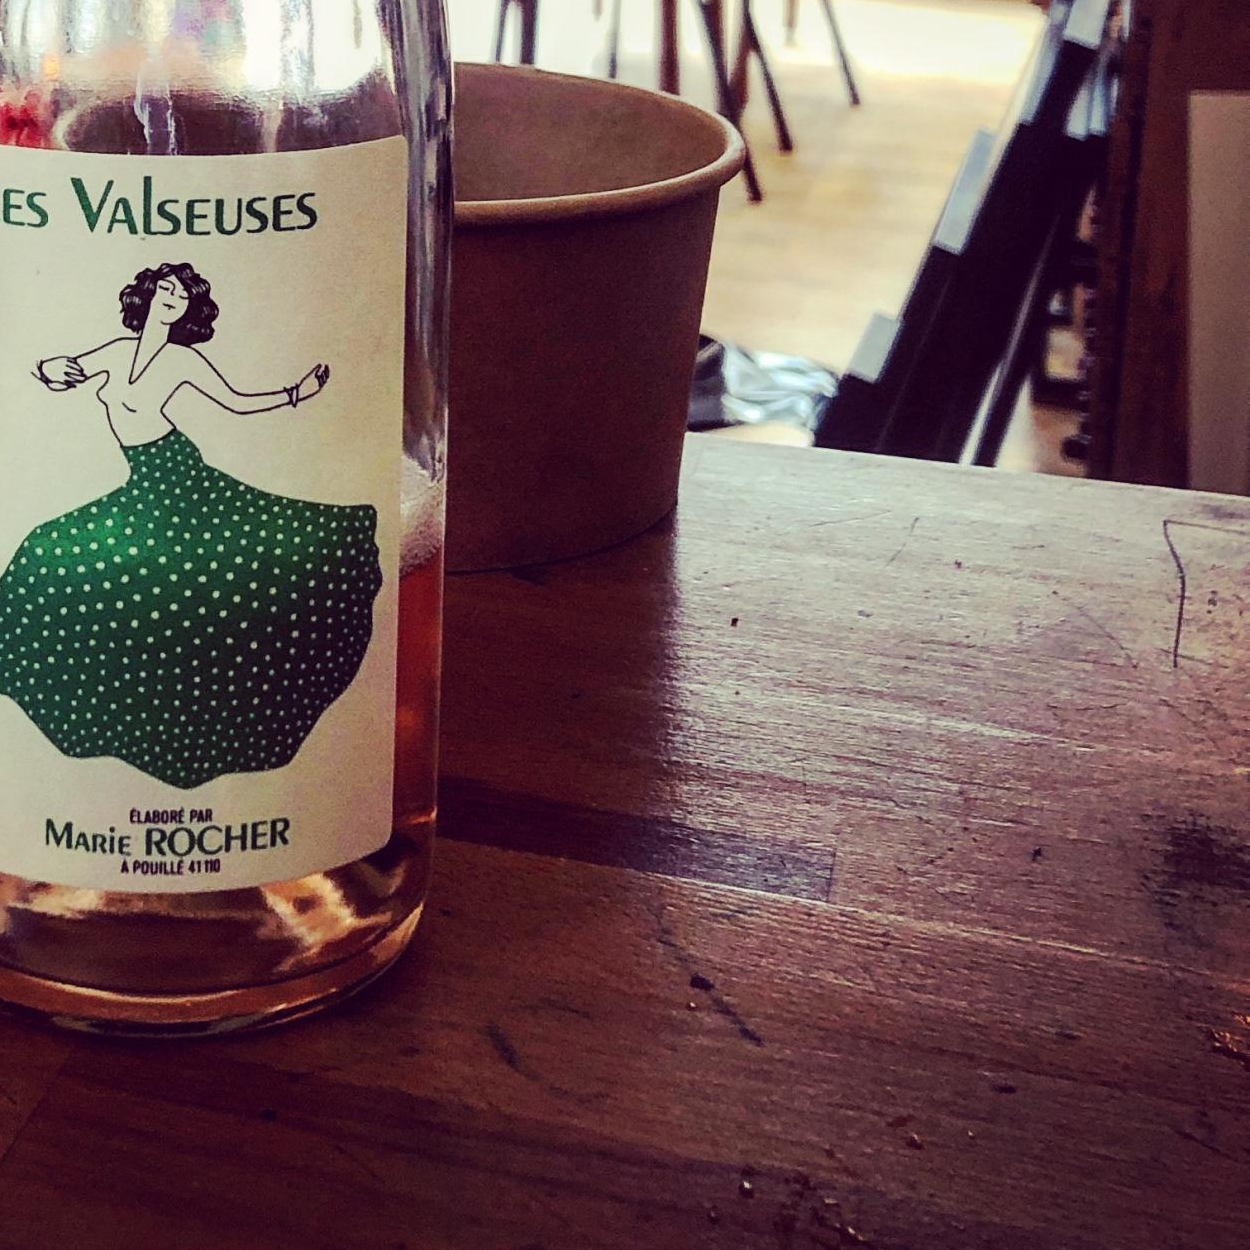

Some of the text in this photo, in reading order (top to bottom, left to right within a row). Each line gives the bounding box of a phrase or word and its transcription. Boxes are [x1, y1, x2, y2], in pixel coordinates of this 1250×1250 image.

[70, 176, 318, 236] VALSEUSES
[129, 807, 213, 824] ÉLABORÉ PAR
[145, 817, 291, 857] ROCHER
